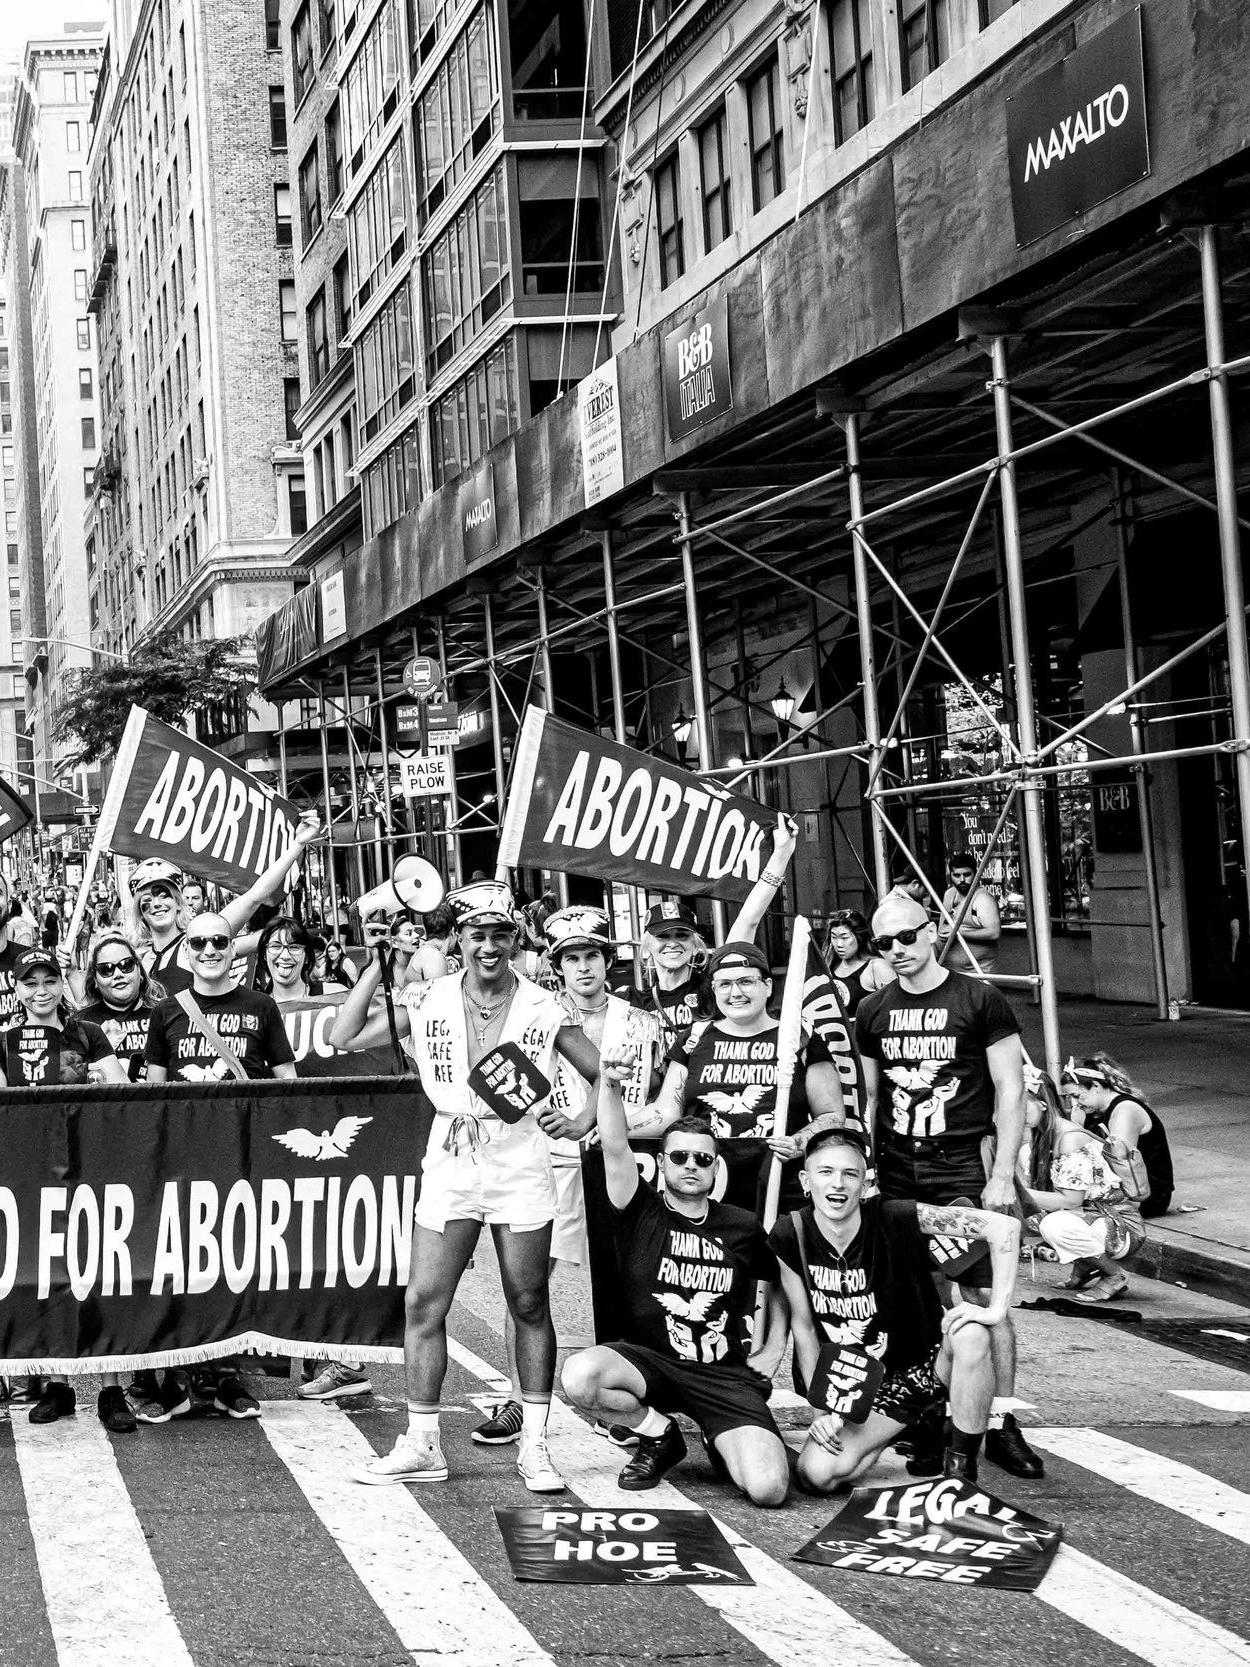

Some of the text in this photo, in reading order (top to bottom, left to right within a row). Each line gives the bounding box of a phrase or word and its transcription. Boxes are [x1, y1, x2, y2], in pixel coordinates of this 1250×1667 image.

[1024, 83, 1129, 183] MAXALTO
[678, 323, 713, 381] B&B
[680, 365, 716, 422] ITALIA
[466, 498, 491, 532] MAXALTO
[398, 706, 419, 718] BxM3
[398, 719, 419, 730] BxM4
[407, 762, 445, 776] RAISE
[410, 775, 445, 790] PLOW
[1100, 785, 1130, 811] B&B
[543, 749, 766, 881] ABORTION
[961, 812, 978, 829] You
[968, 830, 987, 845] don't
[220, 1014, 240, 1032] GOD
[889, 1008, 948, 1032] THANK GOD
[178, 1038, 196, 1058] FOR
[713, 1040, 775, 1060] THANK GOD
[903, 1036, 957, 1060] ABORTION
[434, 1064, 453, 1083] REE
[699, 1063, 723, 1083] FOR
[38, 1183, 136, 1301] FOR
[150, 1174, 417, 1297] ABORTION
[658, 1257, 680, 1285] FOR
[541, 1511, 660, 1532] PRO
[553, 1541, 678, 1562] HOE
[864, 1529, 1023, 1561] SAFE
[831, 1551, 993, 1585] FREE
